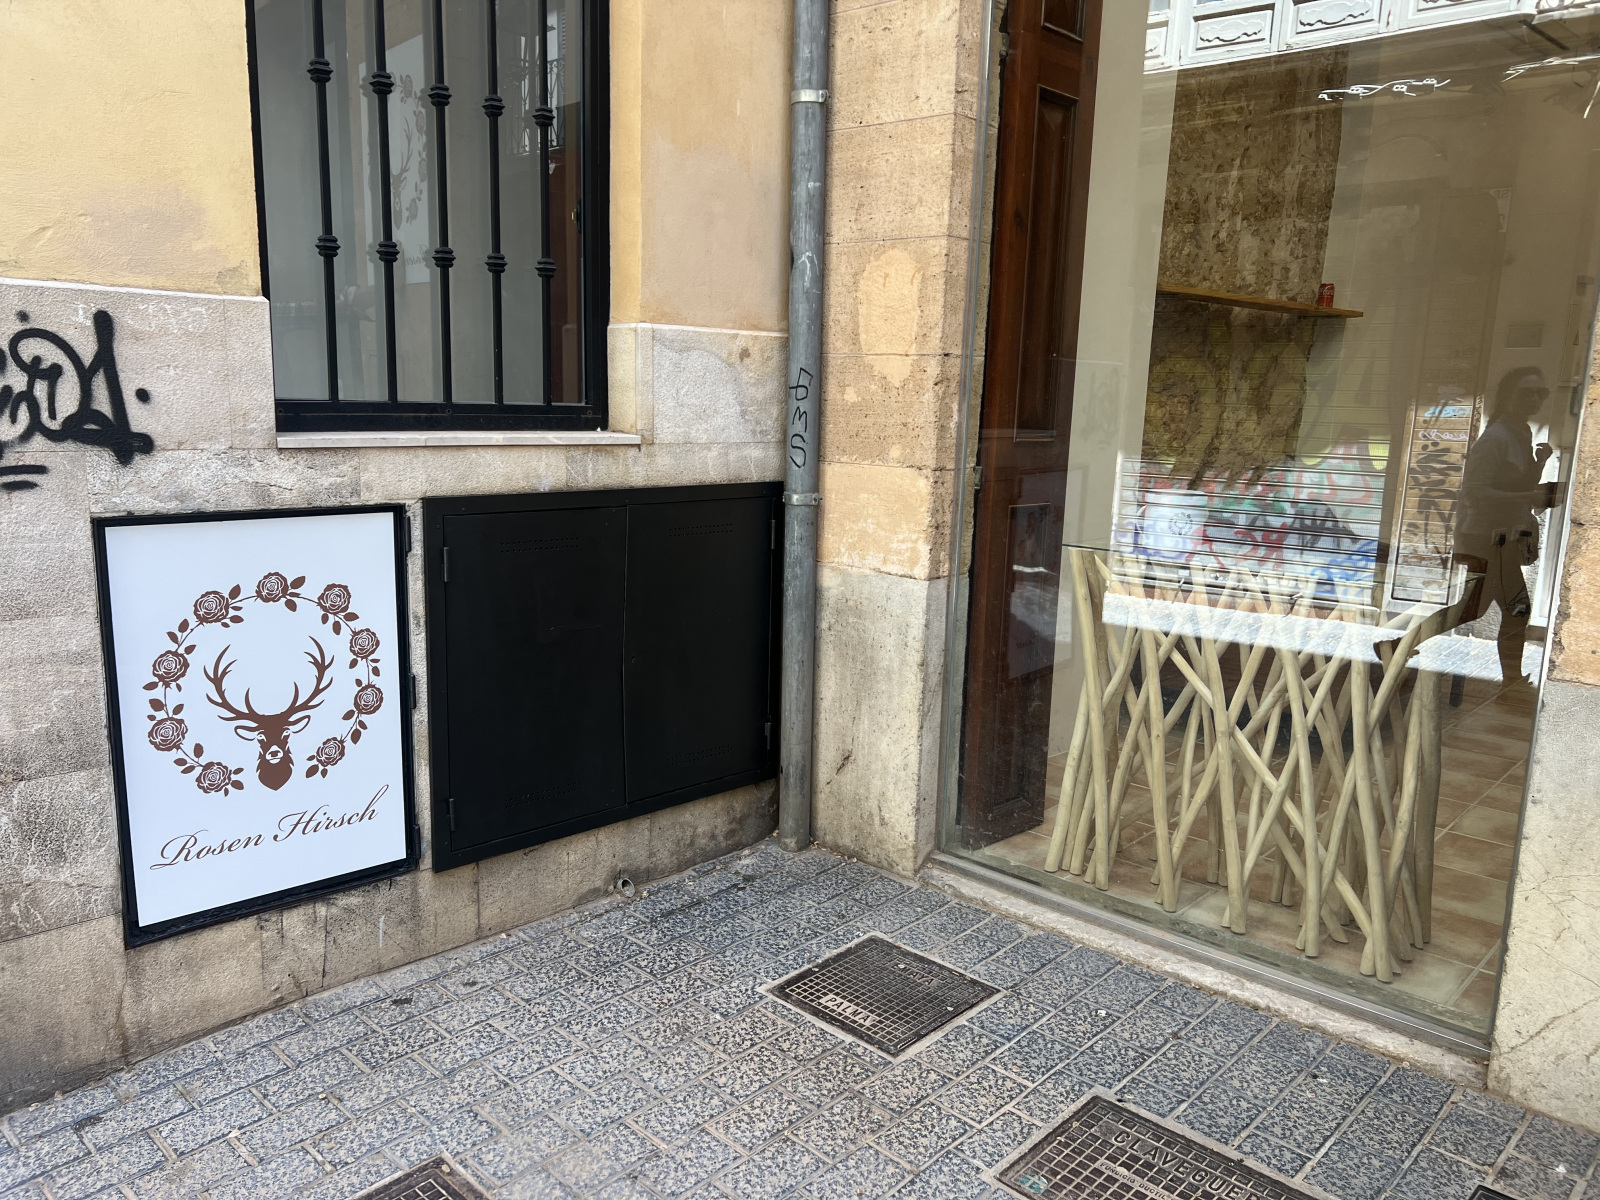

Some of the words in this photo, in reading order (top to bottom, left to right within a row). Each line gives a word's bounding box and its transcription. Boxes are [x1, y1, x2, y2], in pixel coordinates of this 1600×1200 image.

[149, 829, 266, 871] Rosen
[272, 783, 390, 843] Hirsch
[825, 995, 872, 1025] PALMA
